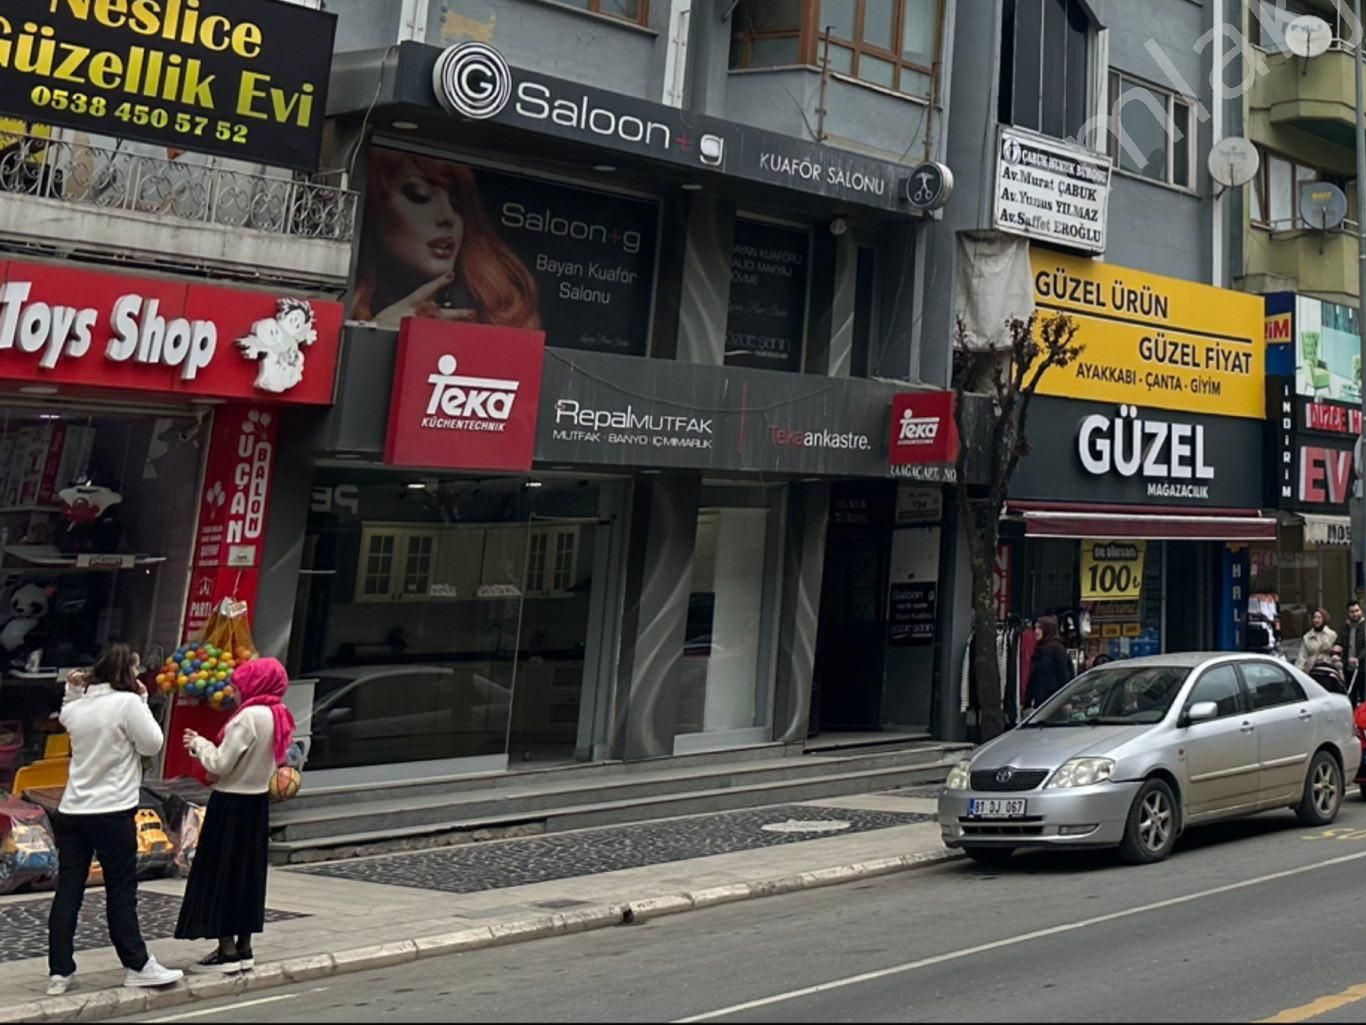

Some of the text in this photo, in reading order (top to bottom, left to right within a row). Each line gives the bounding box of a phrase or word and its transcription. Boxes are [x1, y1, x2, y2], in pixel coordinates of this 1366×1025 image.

[31, 86, 249, 144] 0538 450 57 52
[236, 70, 314, 128] Evi
[759, 152, 885, 195] KUAFÖR SALONU
[1058, 180, 1097, 202] ÇABUK
[1055, 199, 1098, 222] YILMAZ
[1054, 221, 1101, 242] EROĞLU
[536, 253, 582, 277] Bayan
[559, 282, 611, 304] Salonu
[1035, 267, 1168, 318] GÜZEL ÜRÜN
[0, 281, 217, 380] Toys Shop
[1139, 333, 1252, 374] GÜZEL FİYAT
[1076, 362, 1221, 396] AYAKKABI ÇANTA GİYİM
[422, 416, 505, 432] KÜCHENTECHNIK
[553, 430, 601, 442] MUTFAK
[608, 433, 648, 445] BANYO
[1078, 404, 1215, 479] GÜZEL
[226, 434, 255, 543] UÇAN
[250, 448, 268, 532] BALON
[1148, 482, 1209, 499] MAĞAZACILIK
